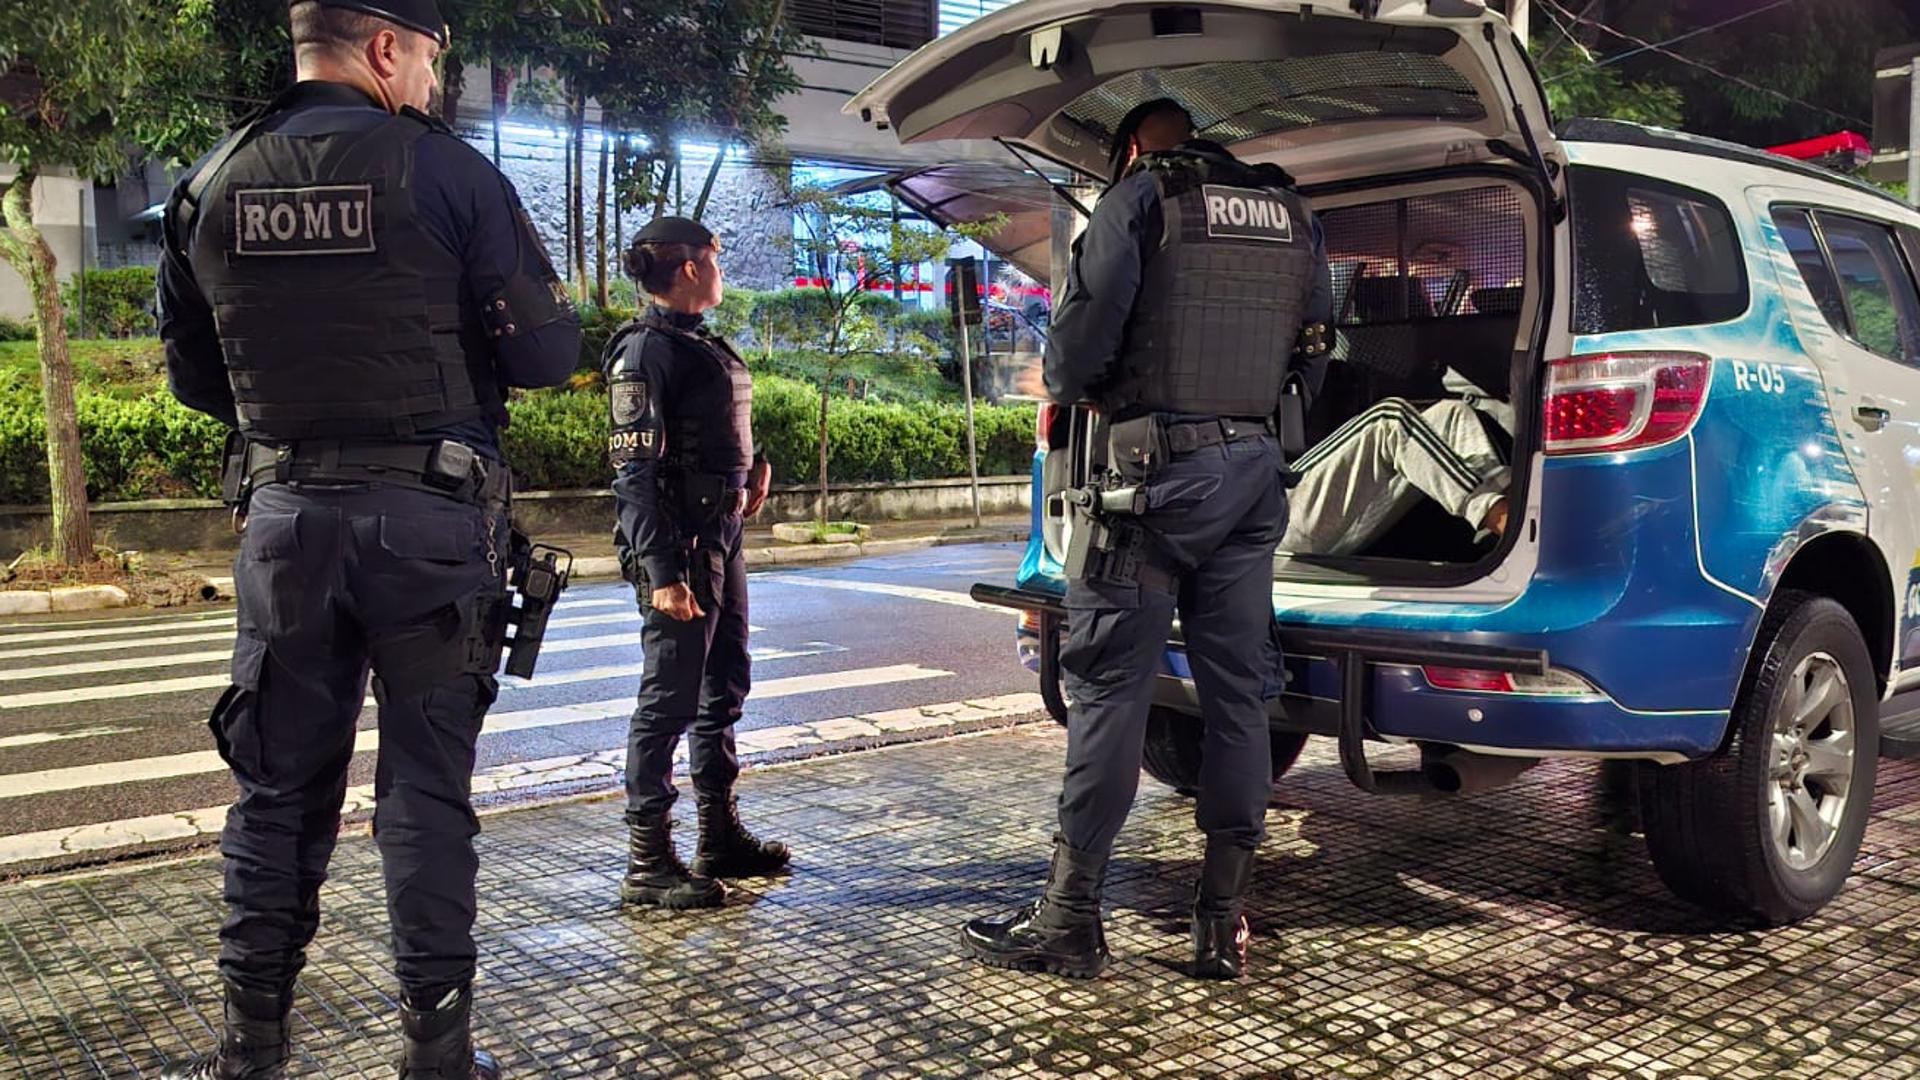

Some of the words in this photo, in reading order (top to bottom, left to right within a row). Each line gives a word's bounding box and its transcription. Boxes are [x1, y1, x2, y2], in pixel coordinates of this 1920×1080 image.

[244, 201, 364, 241] ROMU
[1208, 196, 1287, 230] ROMU
[1732, 360, 1785, 394] R-05
